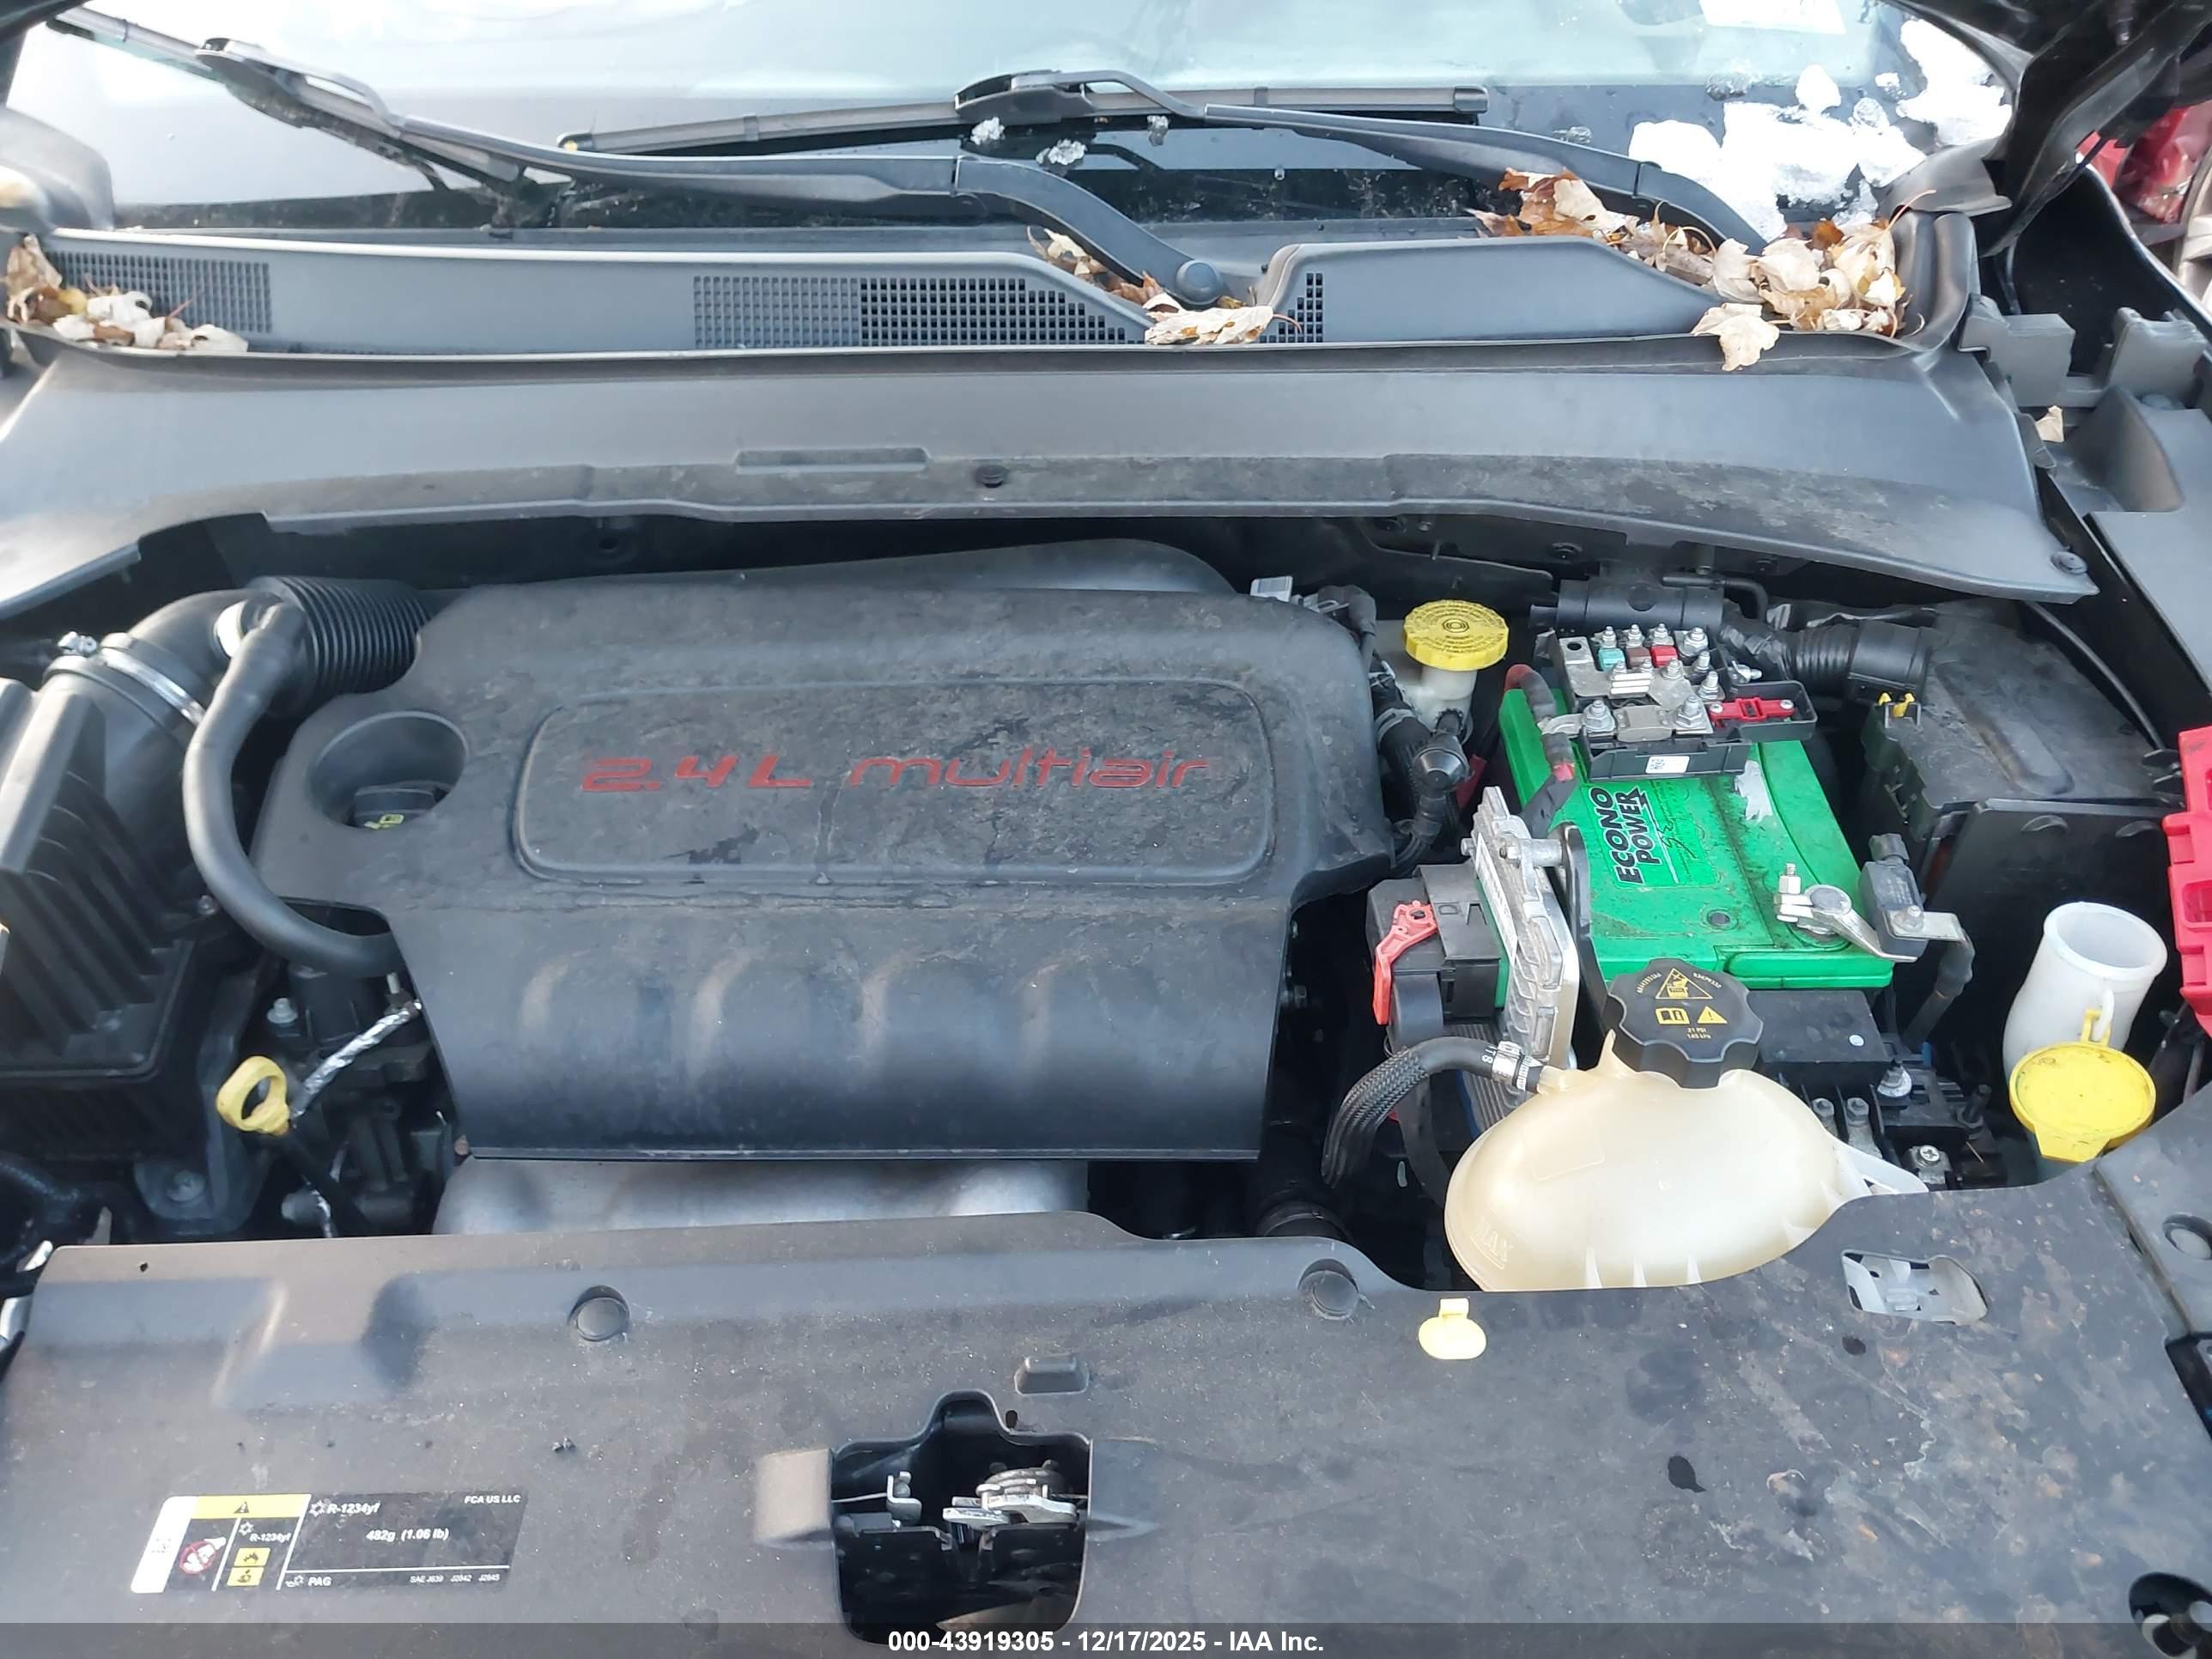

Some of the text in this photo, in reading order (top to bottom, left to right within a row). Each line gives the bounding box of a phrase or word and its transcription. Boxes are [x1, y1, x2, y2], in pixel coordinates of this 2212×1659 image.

[849, 748, 1211, 788] multiair
[1614, 785, 1662, 866] POWER
[1589, 787, 1645, 885] ECONO
[465, 1494, 521, 1504] FCA US LLC
[327, 1501, 380, 1515] R-1234yf
[249, 1532, 292, 1543] R-1234yf
[366, 1528, 449, 1542] 482g (1.06 lb)
[307, 1577, 332, 1587] PAG
